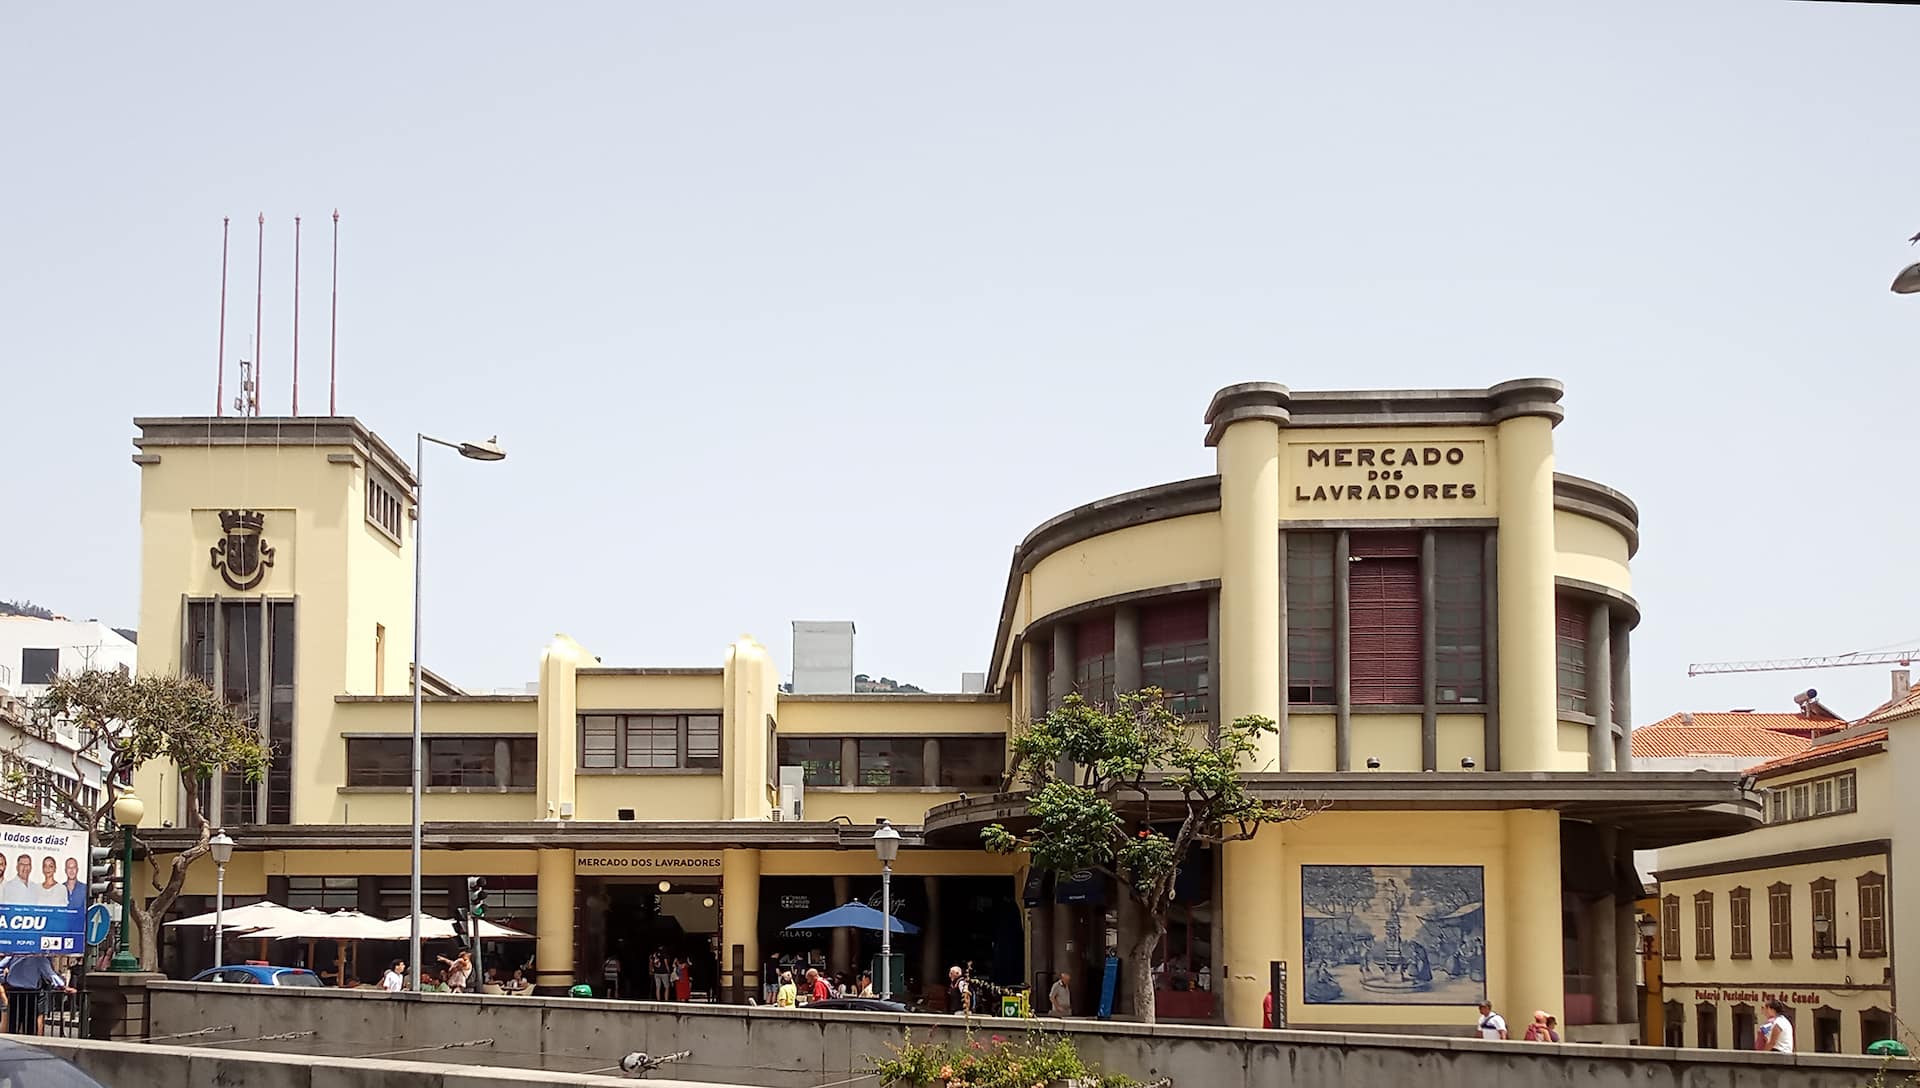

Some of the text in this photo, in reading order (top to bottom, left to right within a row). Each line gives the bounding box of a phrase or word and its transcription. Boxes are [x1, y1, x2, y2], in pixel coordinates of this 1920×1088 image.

[1307, 447, 1464, 467] MERCADO
[1368, 470, 1403, 481] DOS
[1295, 484, 1476, 501] LAVRADORES
[4, 832, 69, 846] todos os dias!
[578, 858, 721, 867] MERCADO DOS LAVRADORES
[10, 916, 47, 930] CDU
